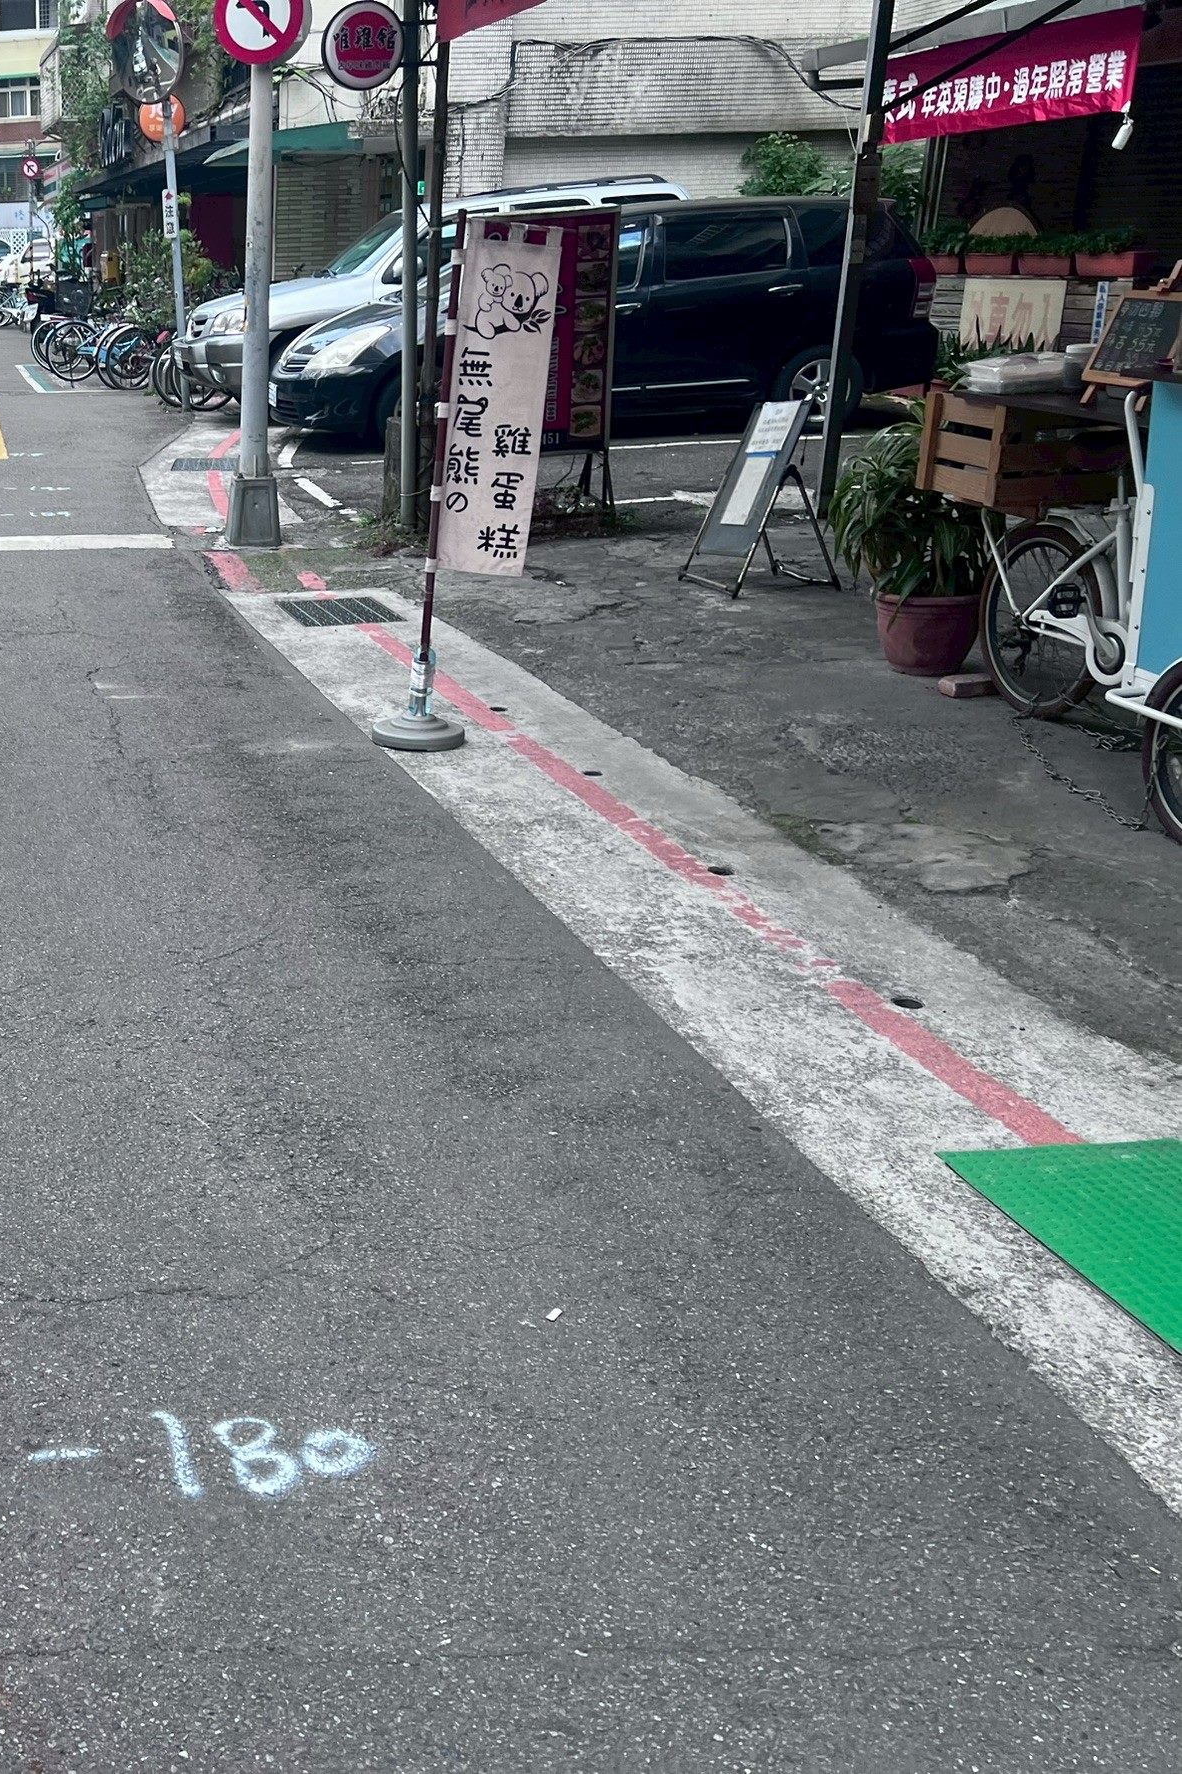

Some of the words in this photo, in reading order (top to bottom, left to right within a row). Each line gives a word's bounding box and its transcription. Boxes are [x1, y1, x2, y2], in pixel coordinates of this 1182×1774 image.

[445, 346, 493, 513] 無尾熊の
[476, 423, 532, 559] 雞蛋糕
